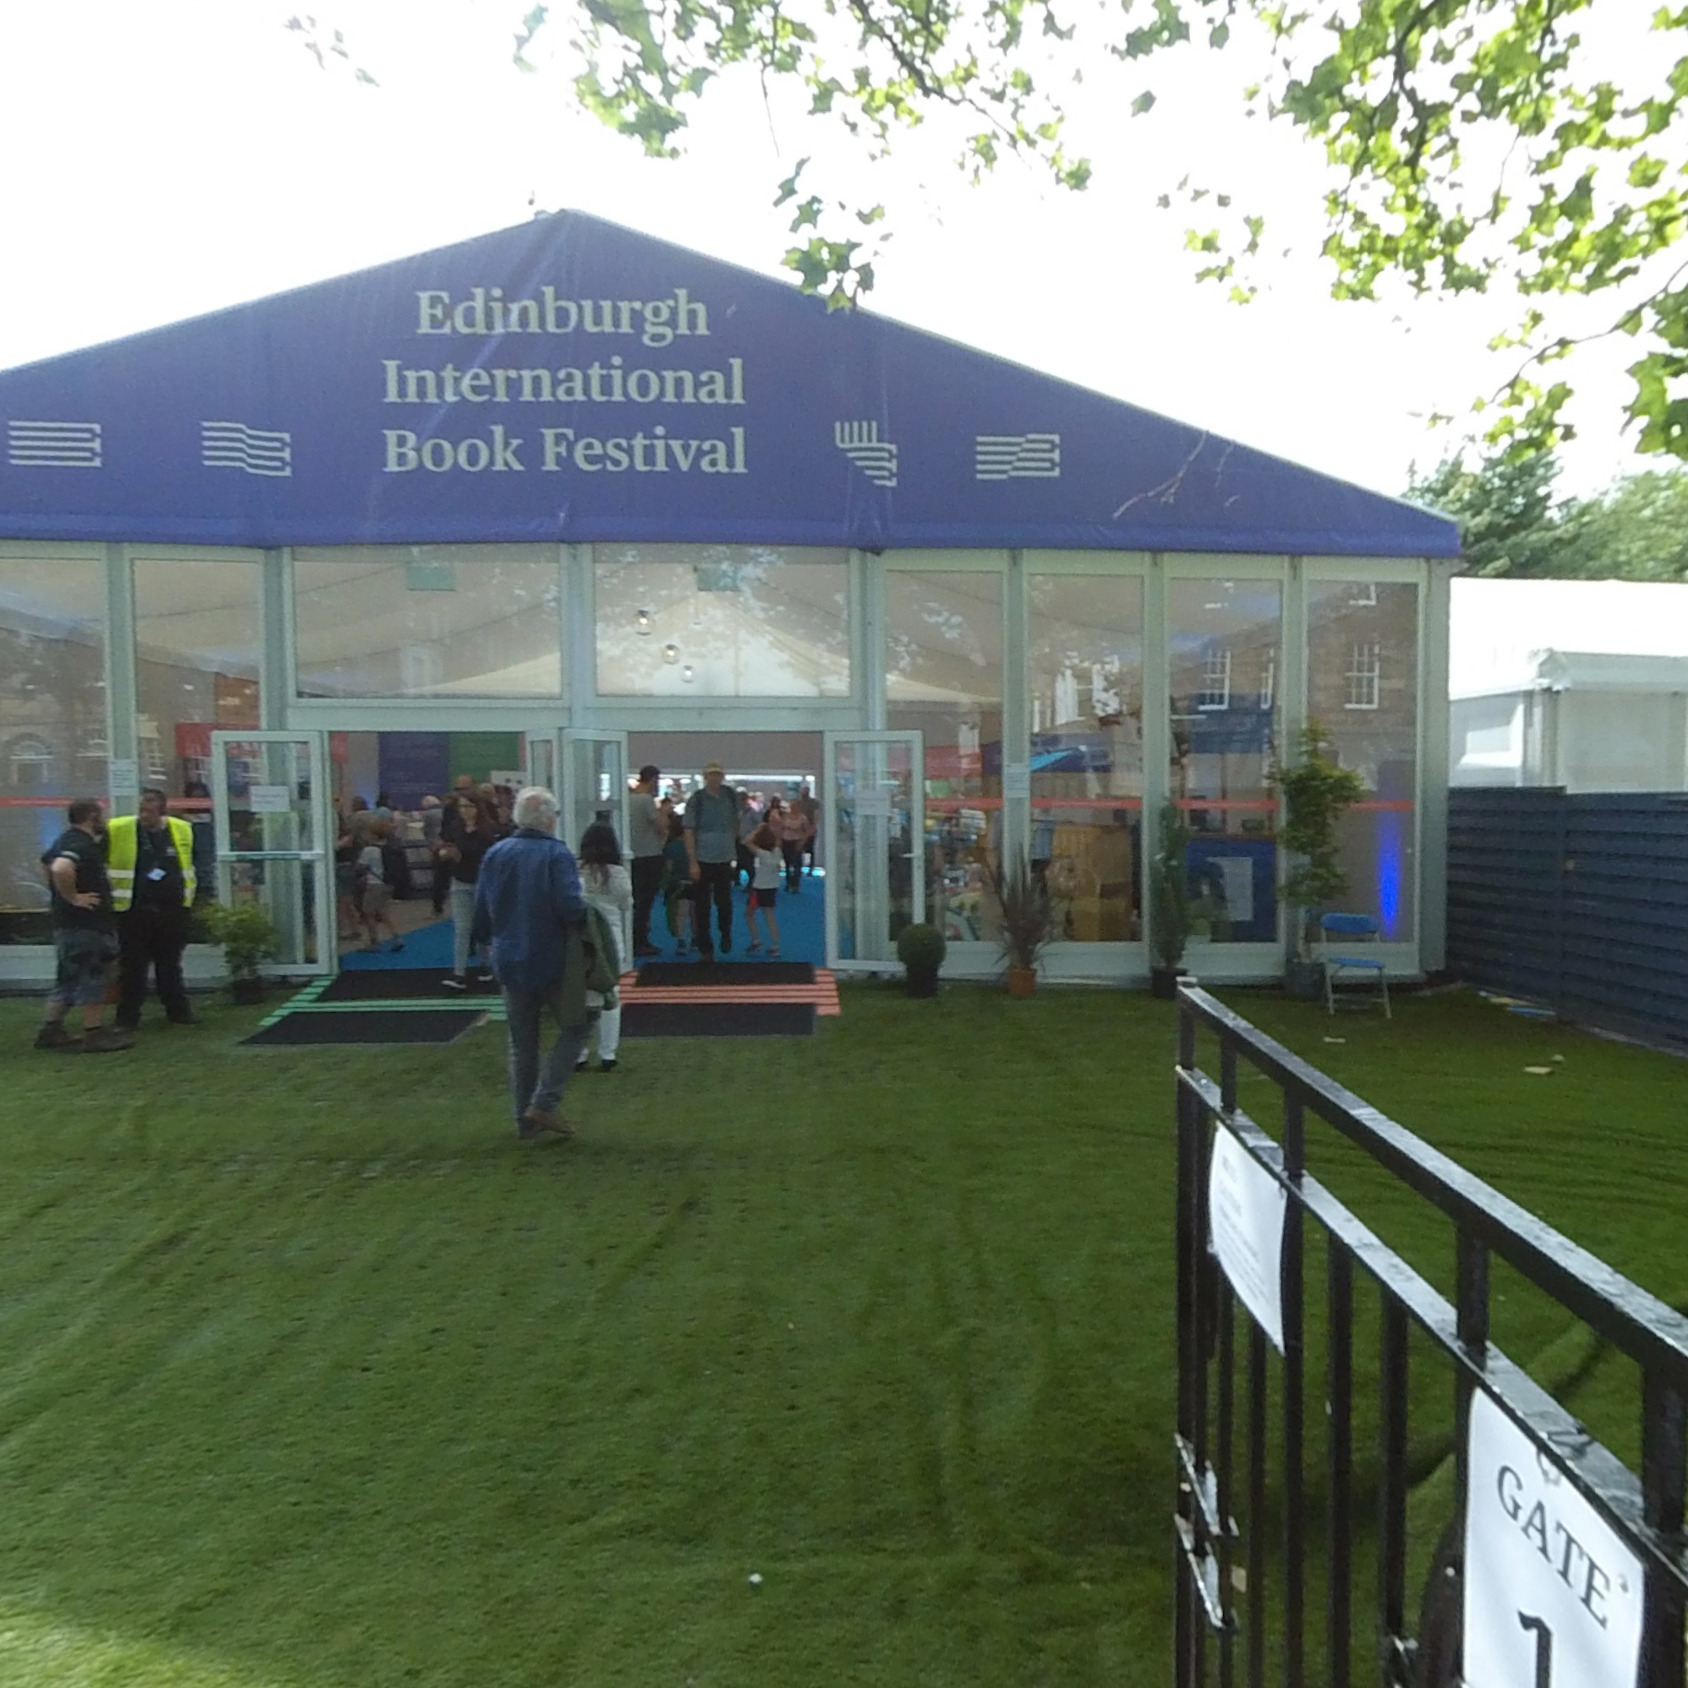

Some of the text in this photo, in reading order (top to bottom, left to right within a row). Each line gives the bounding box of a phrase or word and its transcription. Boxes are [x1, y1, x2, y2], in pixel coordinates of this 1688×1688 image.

[416, 286, 711, 348] Edinburgh
[382, 356, 746, 405] International
[382, 425, 749, 475] Book Festival
[1497, 1465, 1611, 1631] GATE
